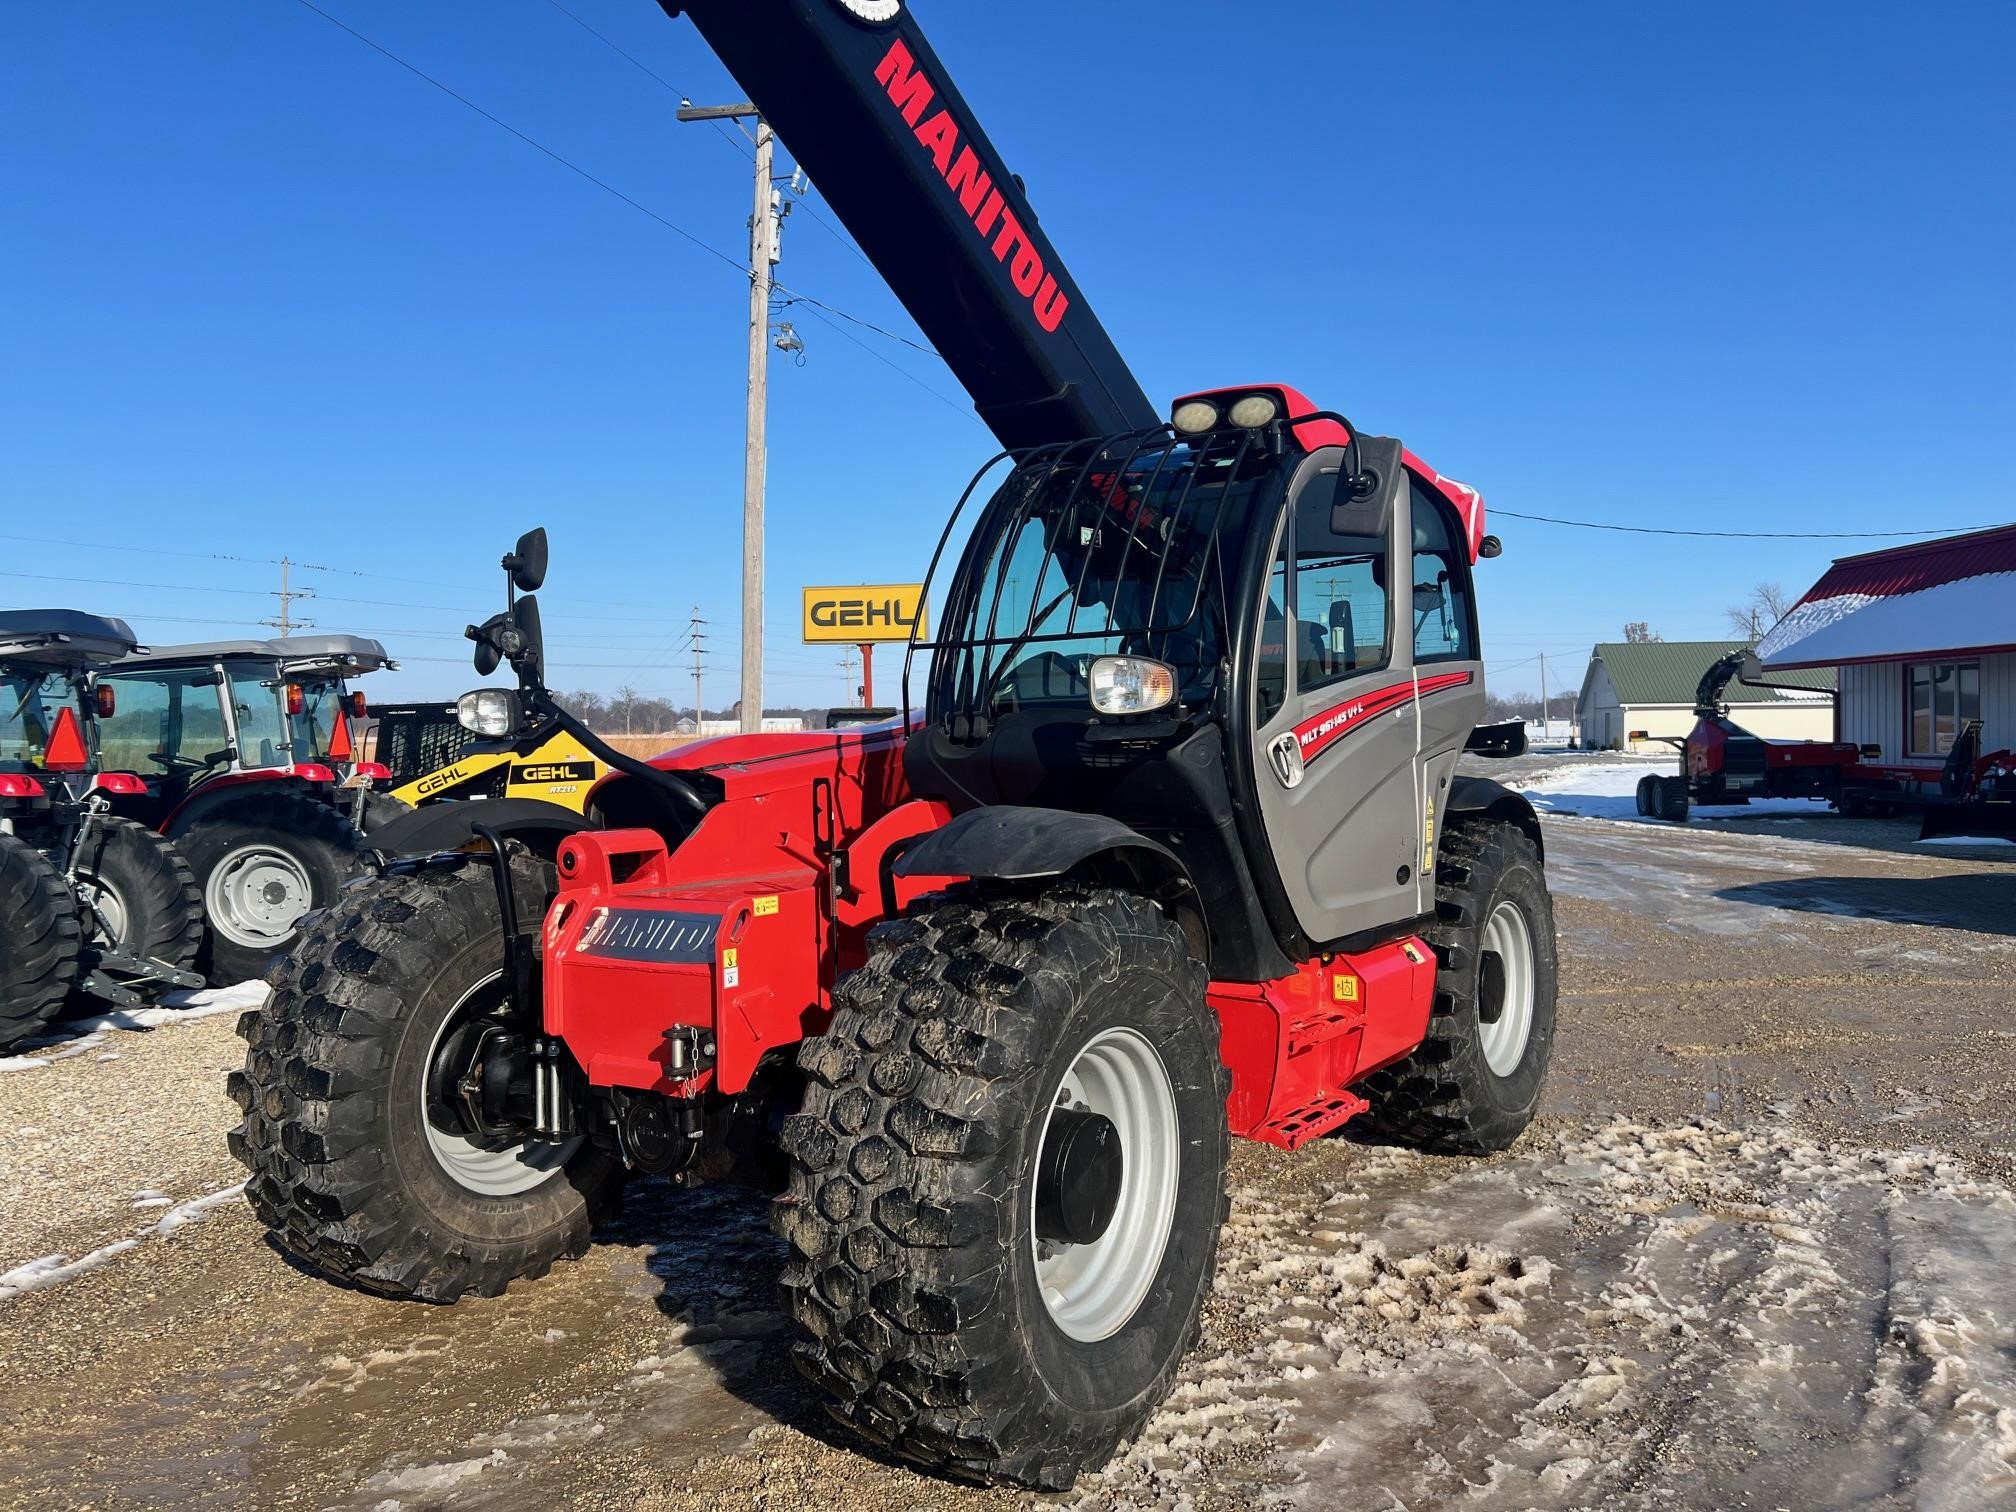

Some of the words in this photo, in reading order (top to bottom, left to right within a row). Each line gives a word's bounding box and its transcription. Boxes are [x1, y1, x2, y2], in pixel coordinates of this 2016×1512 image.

[873, 37, 1069, 333] MANITOU
[811, 599, 915, 626] GEHL
[1301, 727, 1318, 746] MLT
[417, 767, 469, 795] GEHL
[522, 766, 579, 781] GEHL
[460, 1199, 523, 1214] MICHELIN
